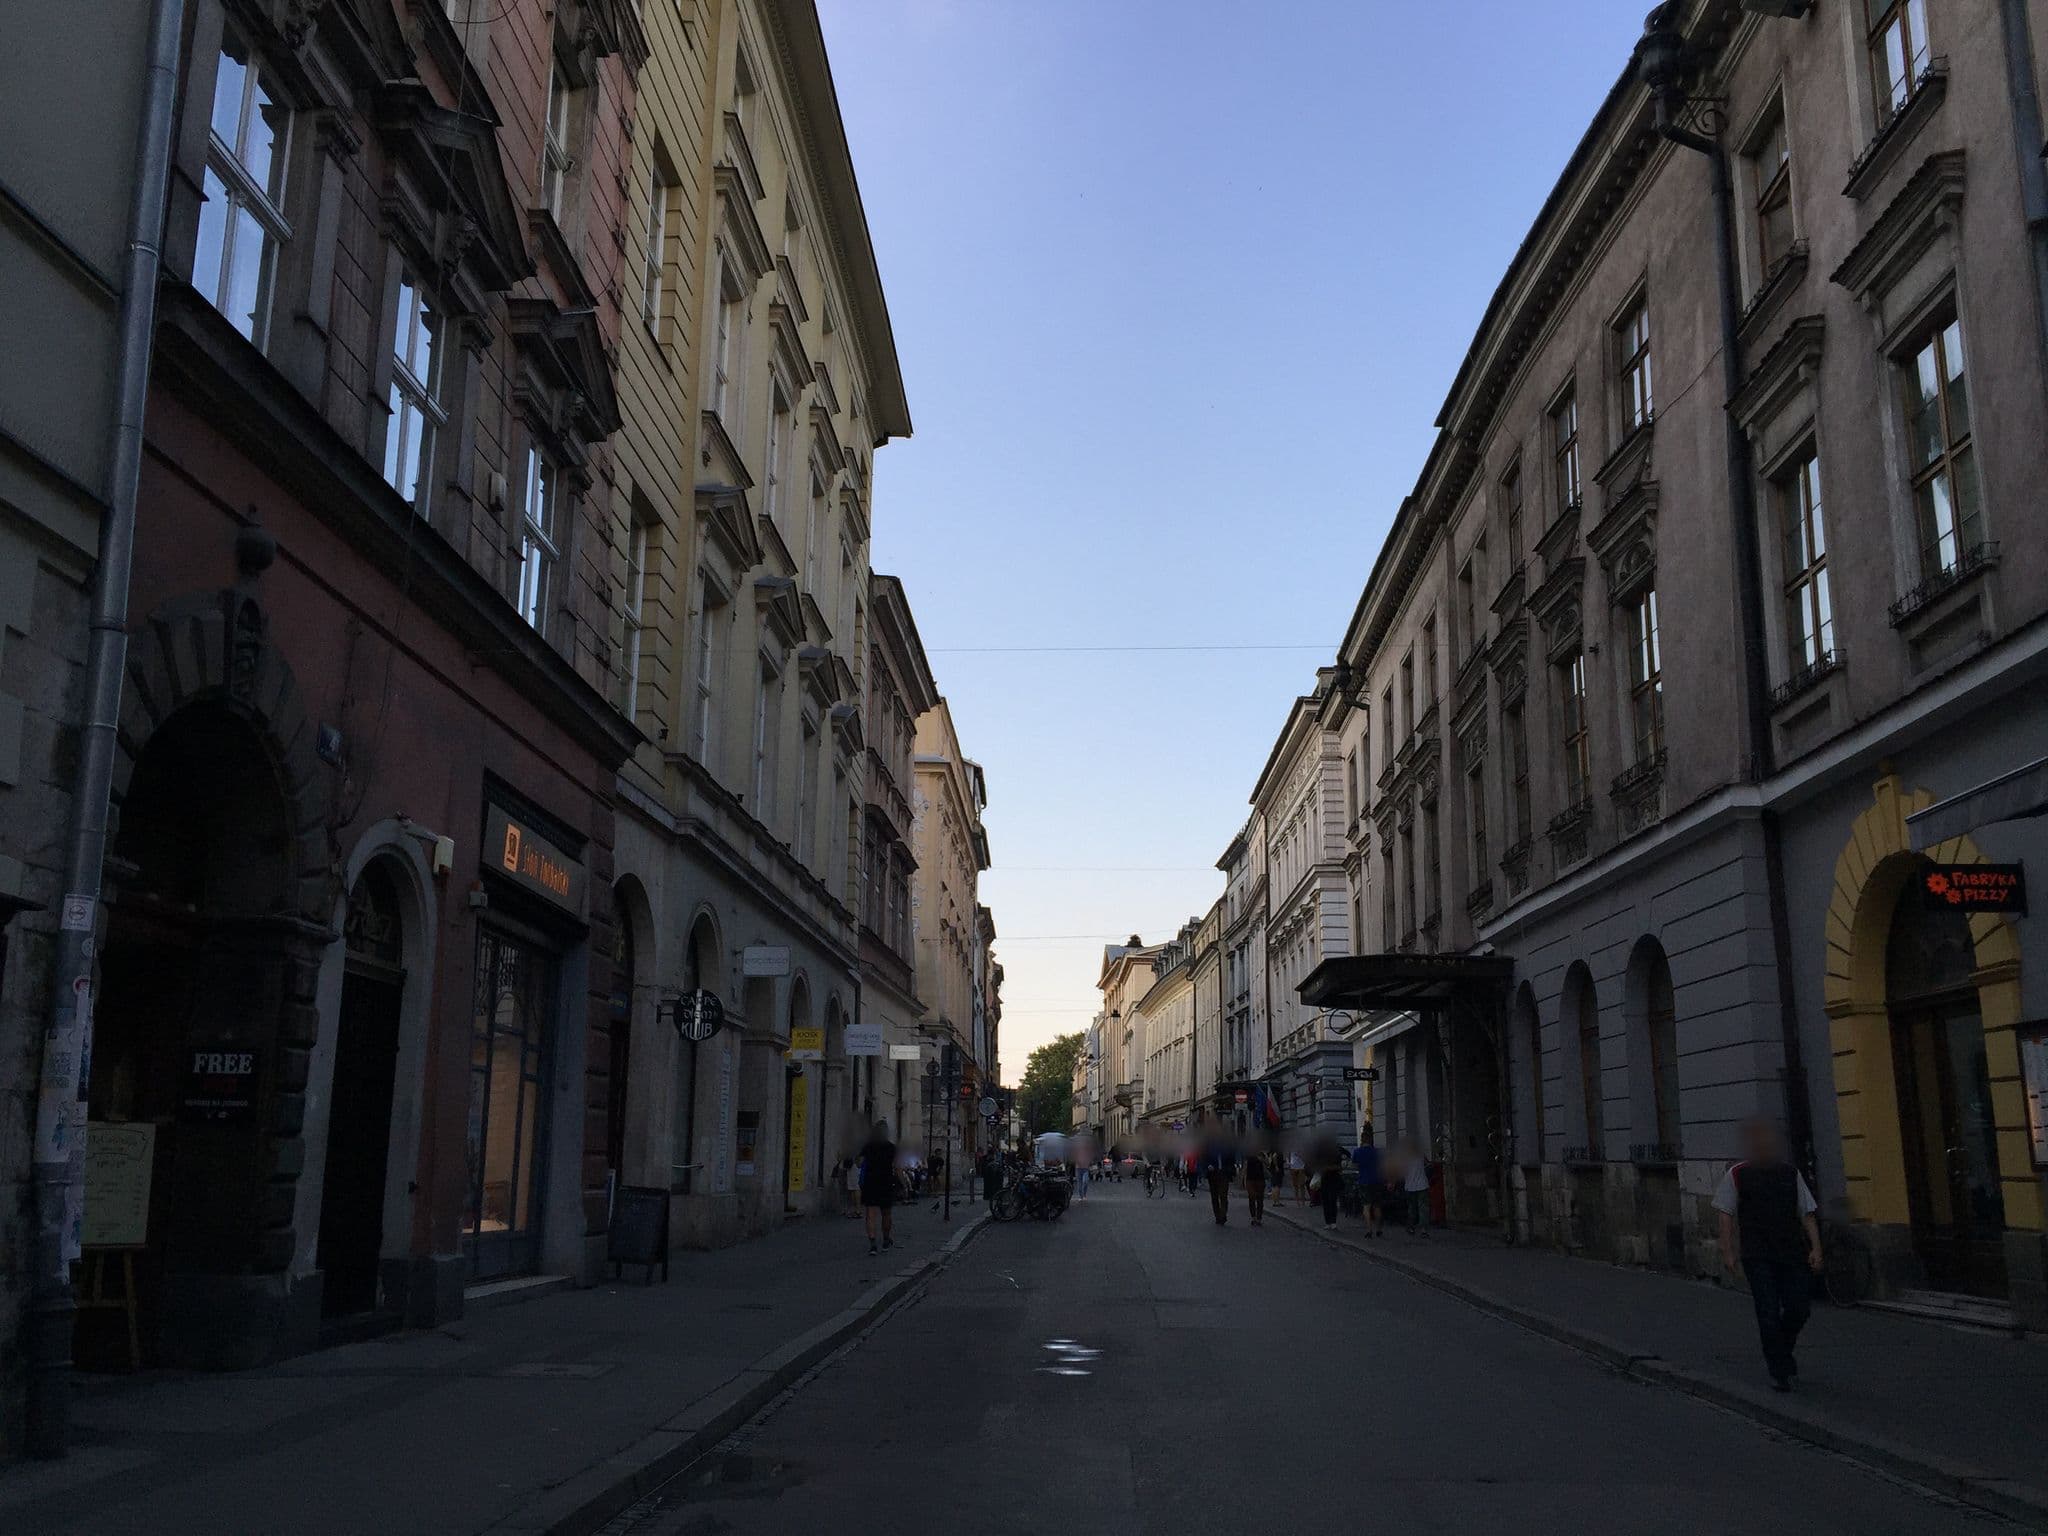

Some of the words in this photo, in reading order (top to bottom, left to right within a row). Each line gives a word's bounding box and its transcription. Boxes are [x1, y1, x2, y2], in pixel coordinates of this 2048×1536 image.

[1952, 871, 2017, 887] FABRYKA
[1963, 888, 2009, 903] PIZZY
[680, 996, 719, 1006] CAPE
[192, 1052, 254, 1074] FREE
